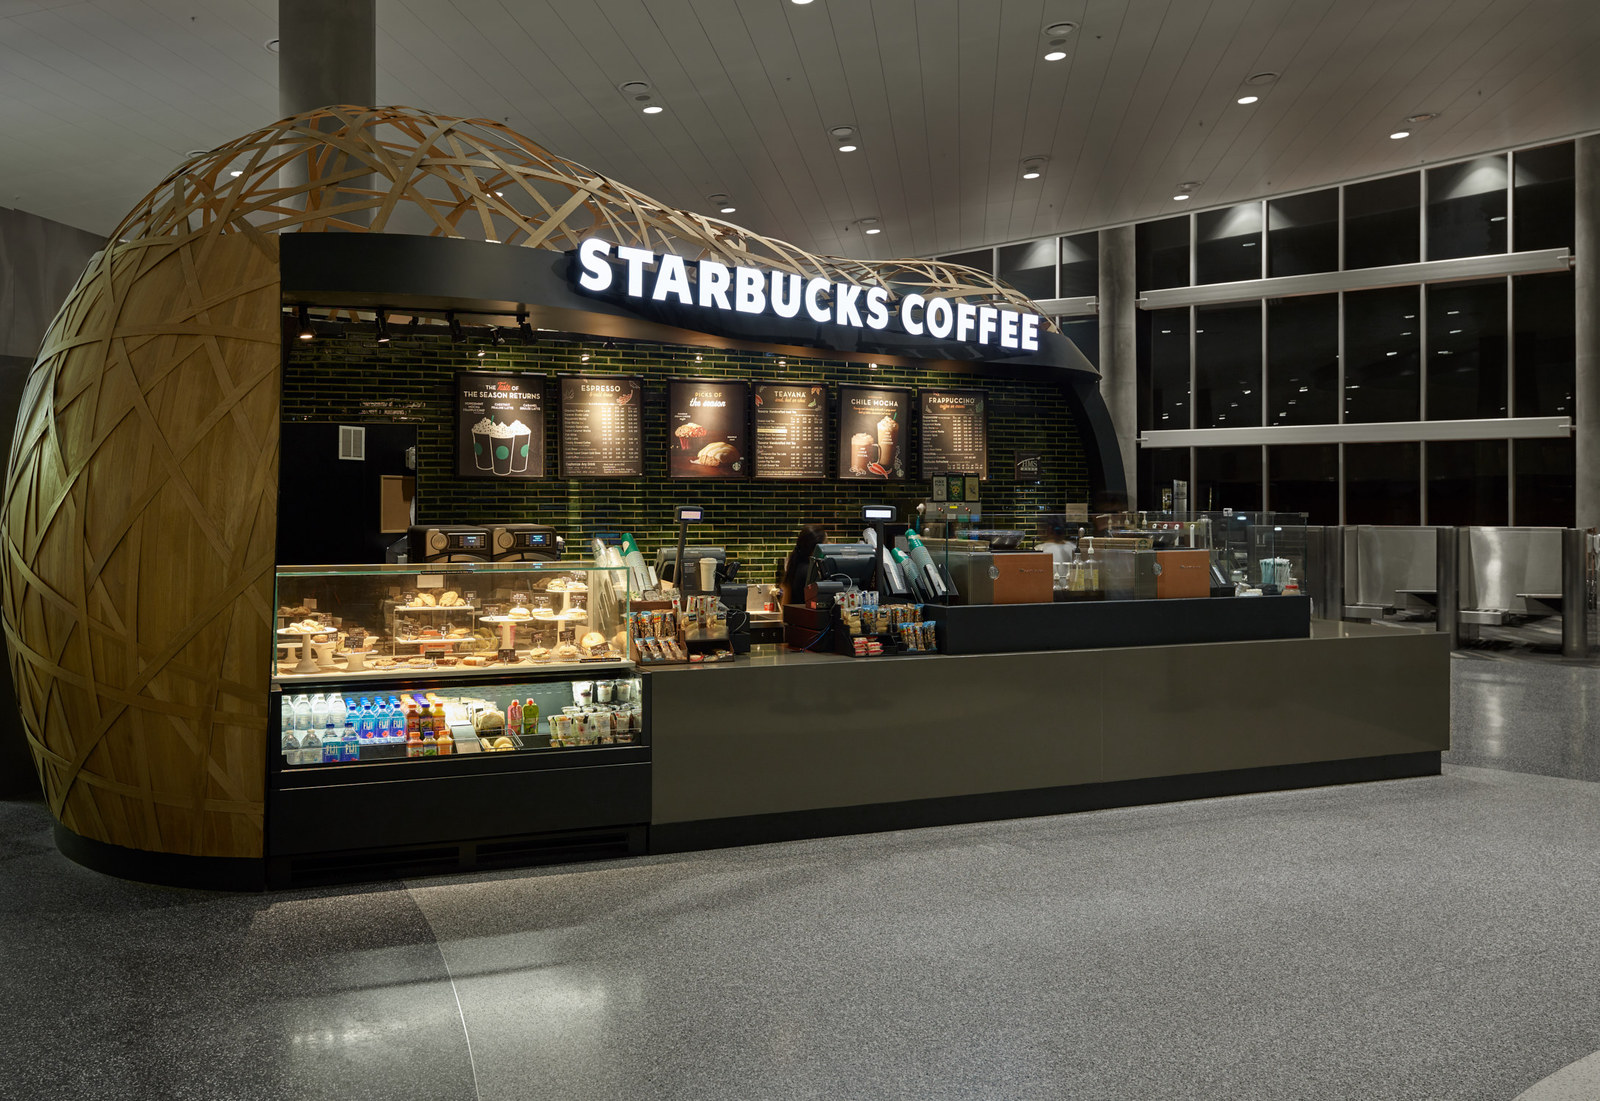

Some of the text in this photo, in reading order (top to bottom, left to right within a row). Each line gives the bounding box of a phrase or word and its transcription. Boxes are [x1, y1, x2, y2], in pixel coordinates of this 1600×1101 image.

[579, 238, 1039, 351] STARBUCKS COFFEE
[581, 384, 621, 392] ESPRESSO
[463, 390, 541, 400] THE SEASON RETURNS
[774, 390, 806, 398] TEAVANA
[689, 396, 701, 407] the
[851, 398, 899, 407] CHILE MOCHA
[363, 721, 374, 730] FIJI
[393, 719, 403, 729] FIJI
[326, 744, 338, 755] FIJI
[345, 743, 357, 754] FIJI
